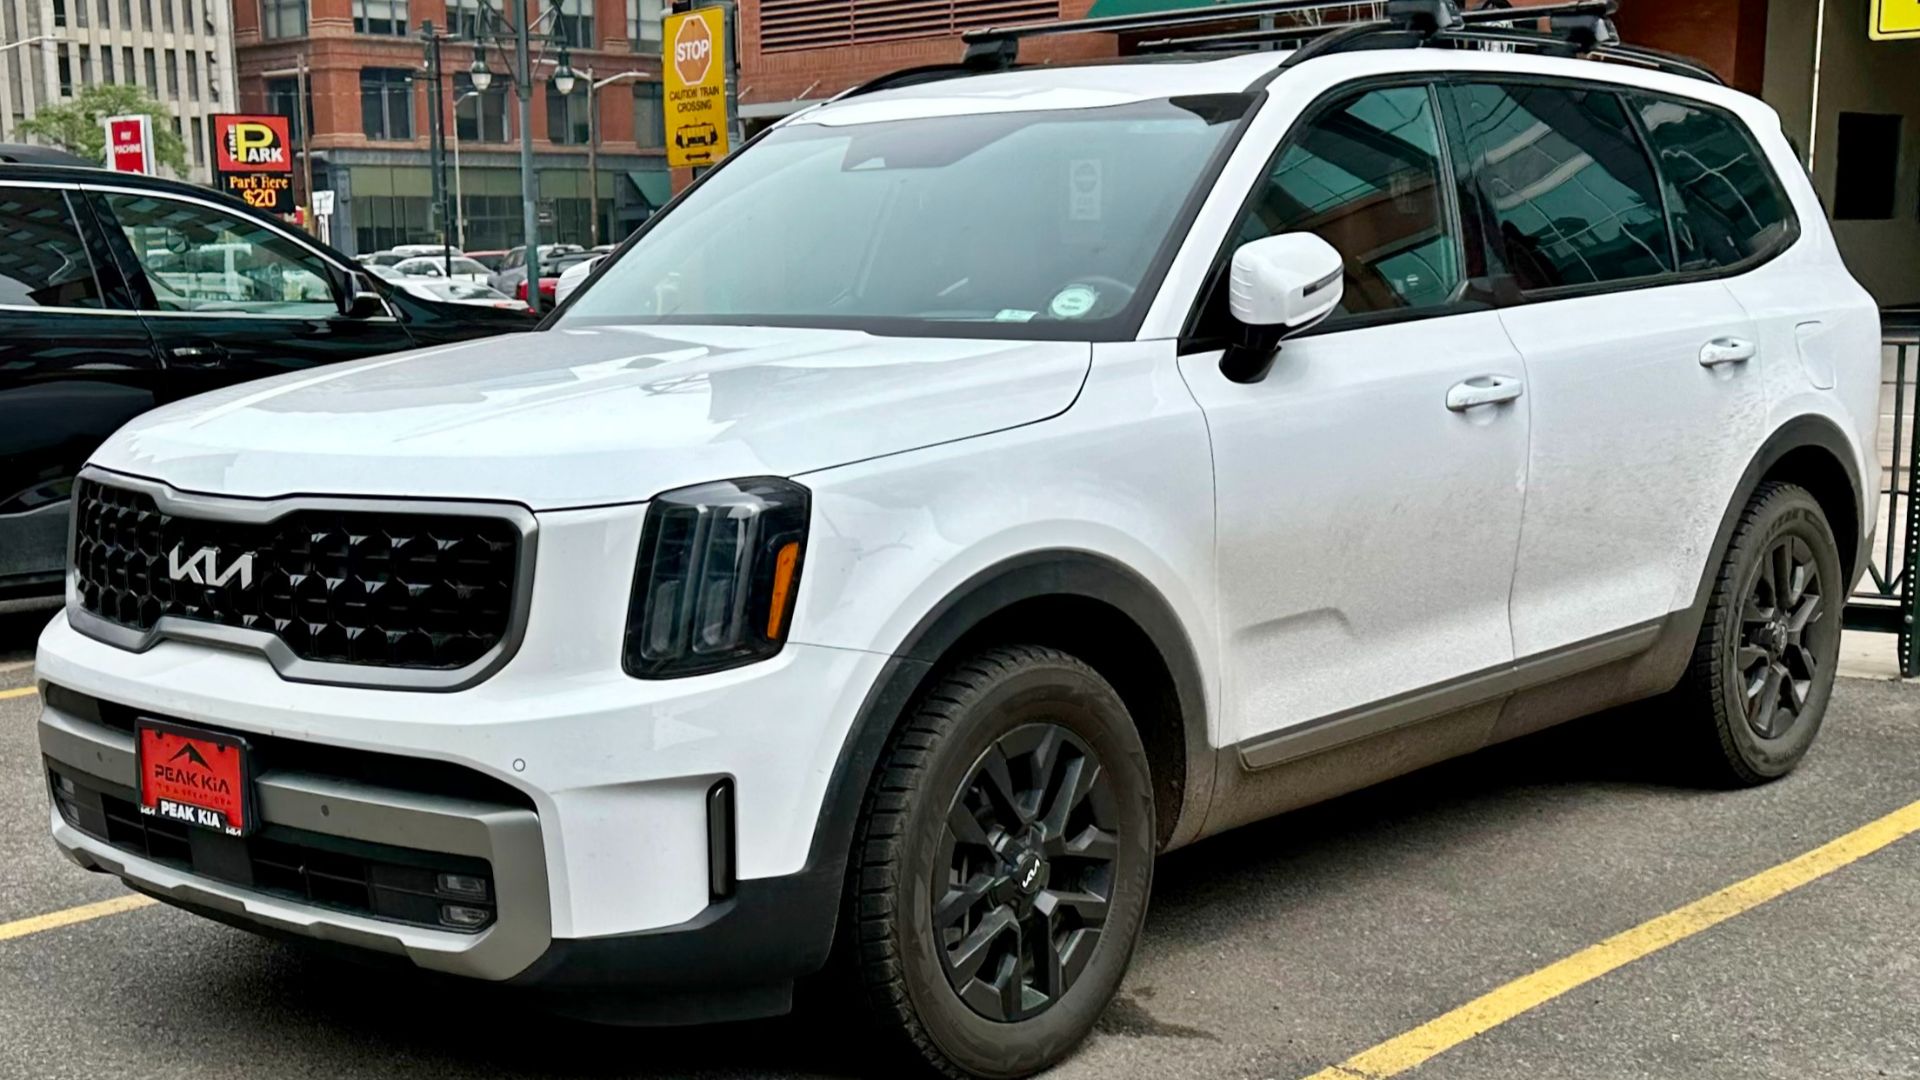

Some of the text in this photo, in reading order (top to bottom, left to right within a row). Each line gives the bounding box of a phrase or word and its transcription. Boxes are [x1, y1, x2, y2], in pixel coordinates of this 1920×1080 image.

[676, 39, 709, 62] STOP
[669, 86, 720, 101] CAUTION TRAIN
[677, 99, 712, 113] CROSSING
[114, 143, 142, 154] MACHINE
[227, 124, 238, 162] TIME
[236, 123, 284, 162] PARK
[229, 176, 288, 189] Park Here
[243, 189, 276, 207] $20
[154, 764, 199, 788] PEAK
[161, 800, 195, 822] PEAK
[198, 809, 221, 828] KIA
